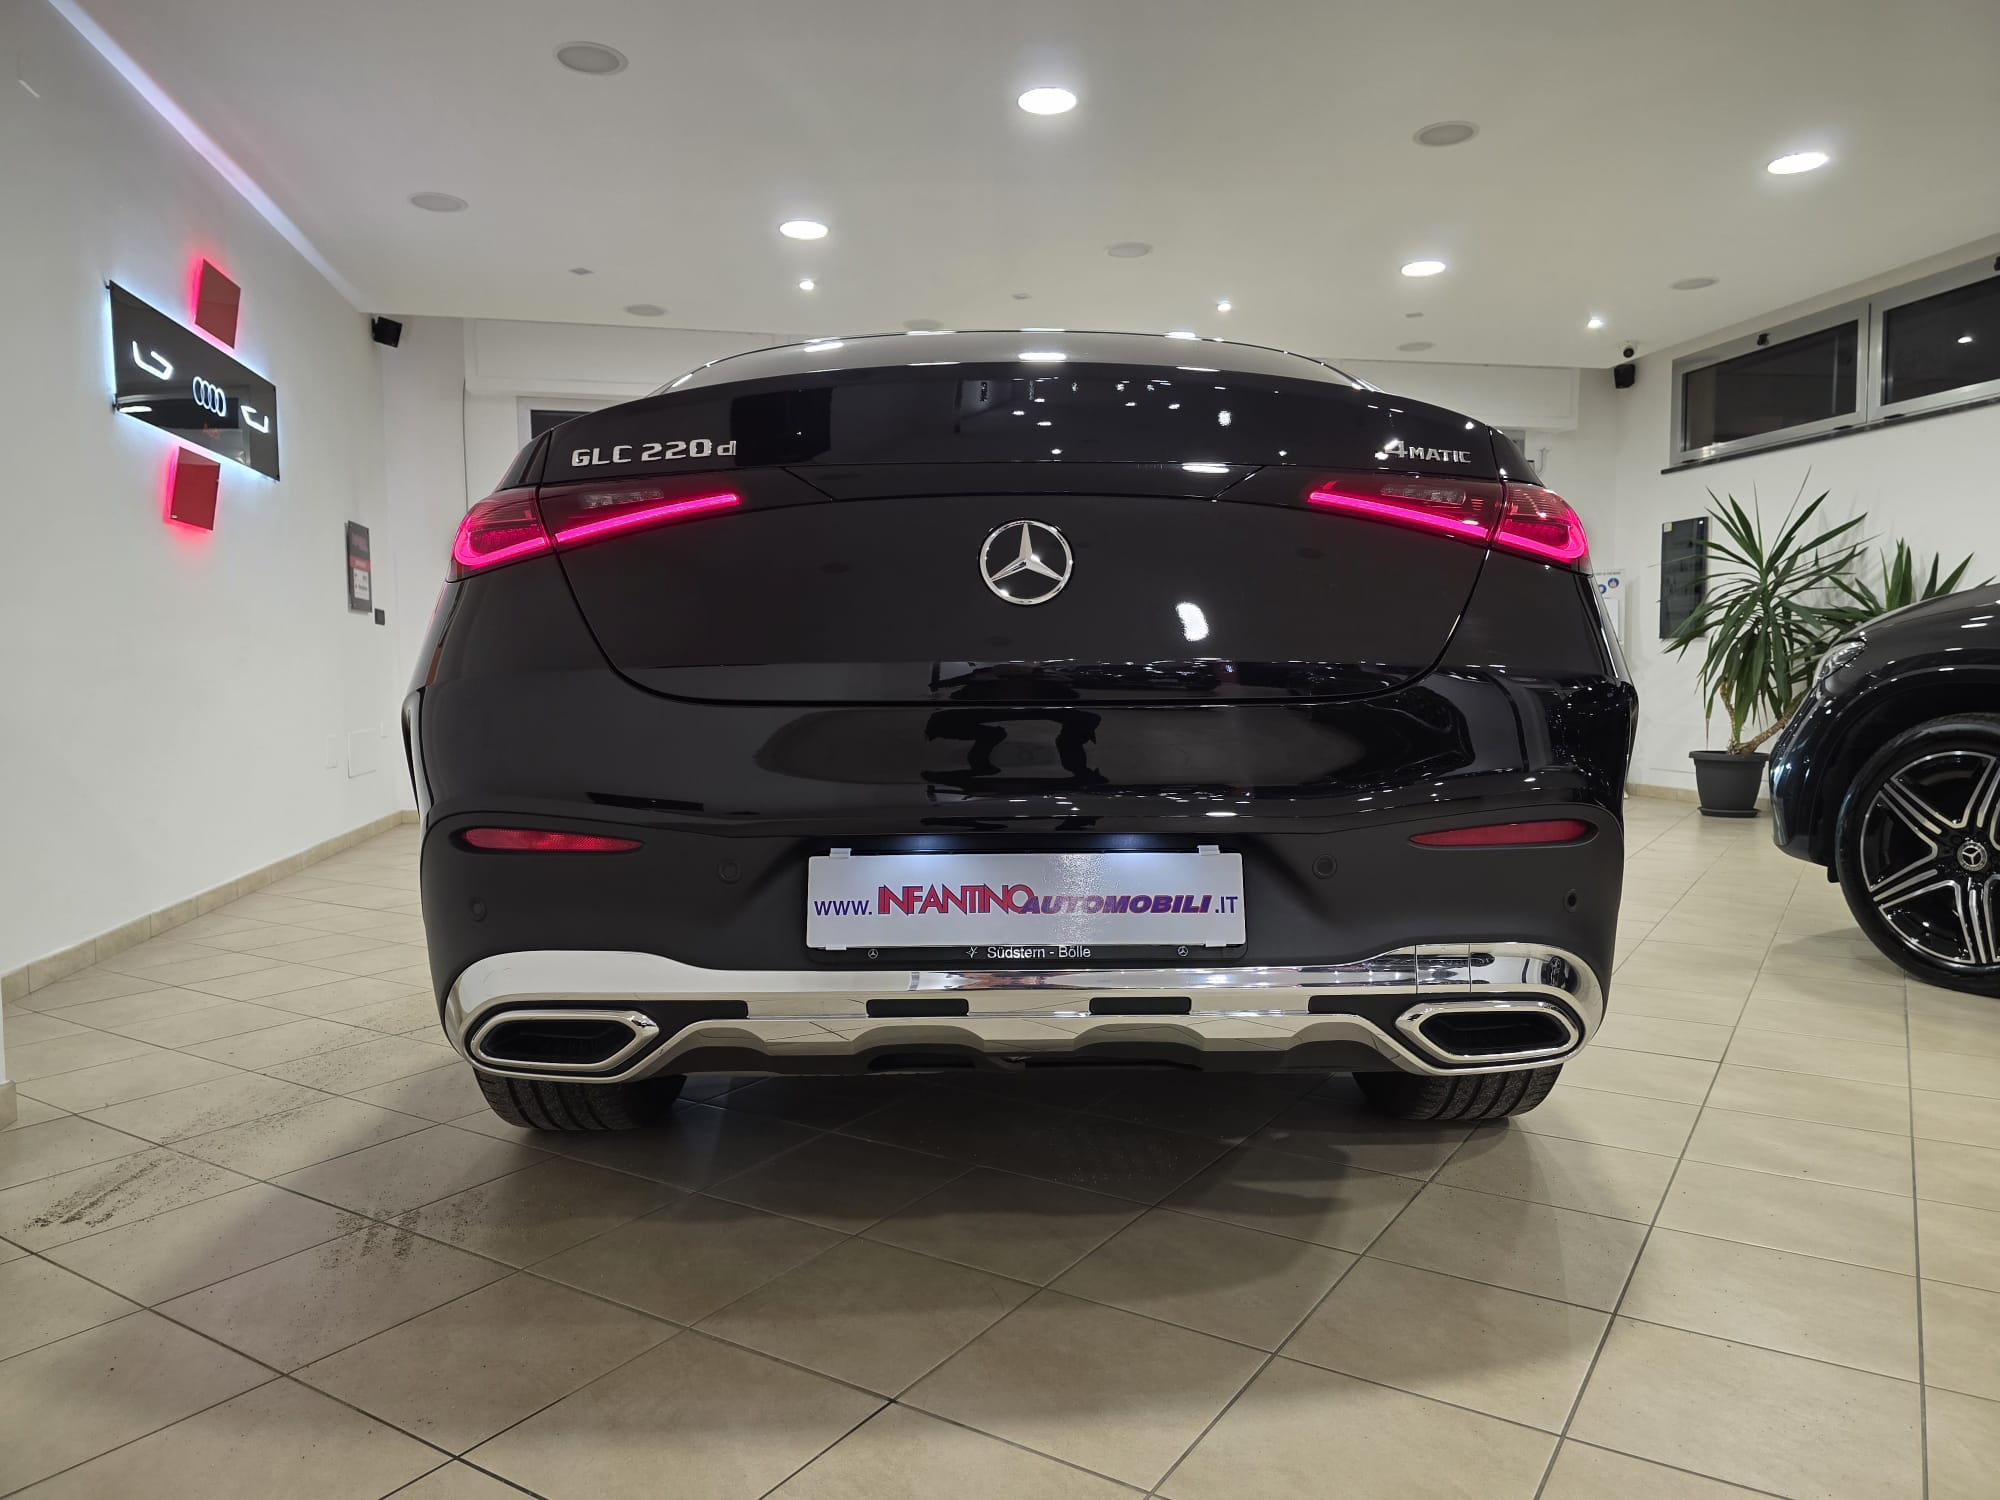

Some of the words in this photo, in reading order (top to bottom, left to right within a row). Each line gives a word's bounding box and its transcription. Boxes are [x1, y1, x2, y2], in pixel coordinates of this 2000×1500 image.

[571, 445, 633, 467] GLC
[1383, 438, 1472, 463] 4MATIC
[986, 946, 1046, 959] Südstern
[1058, 945, 1092, 958] Bölle
